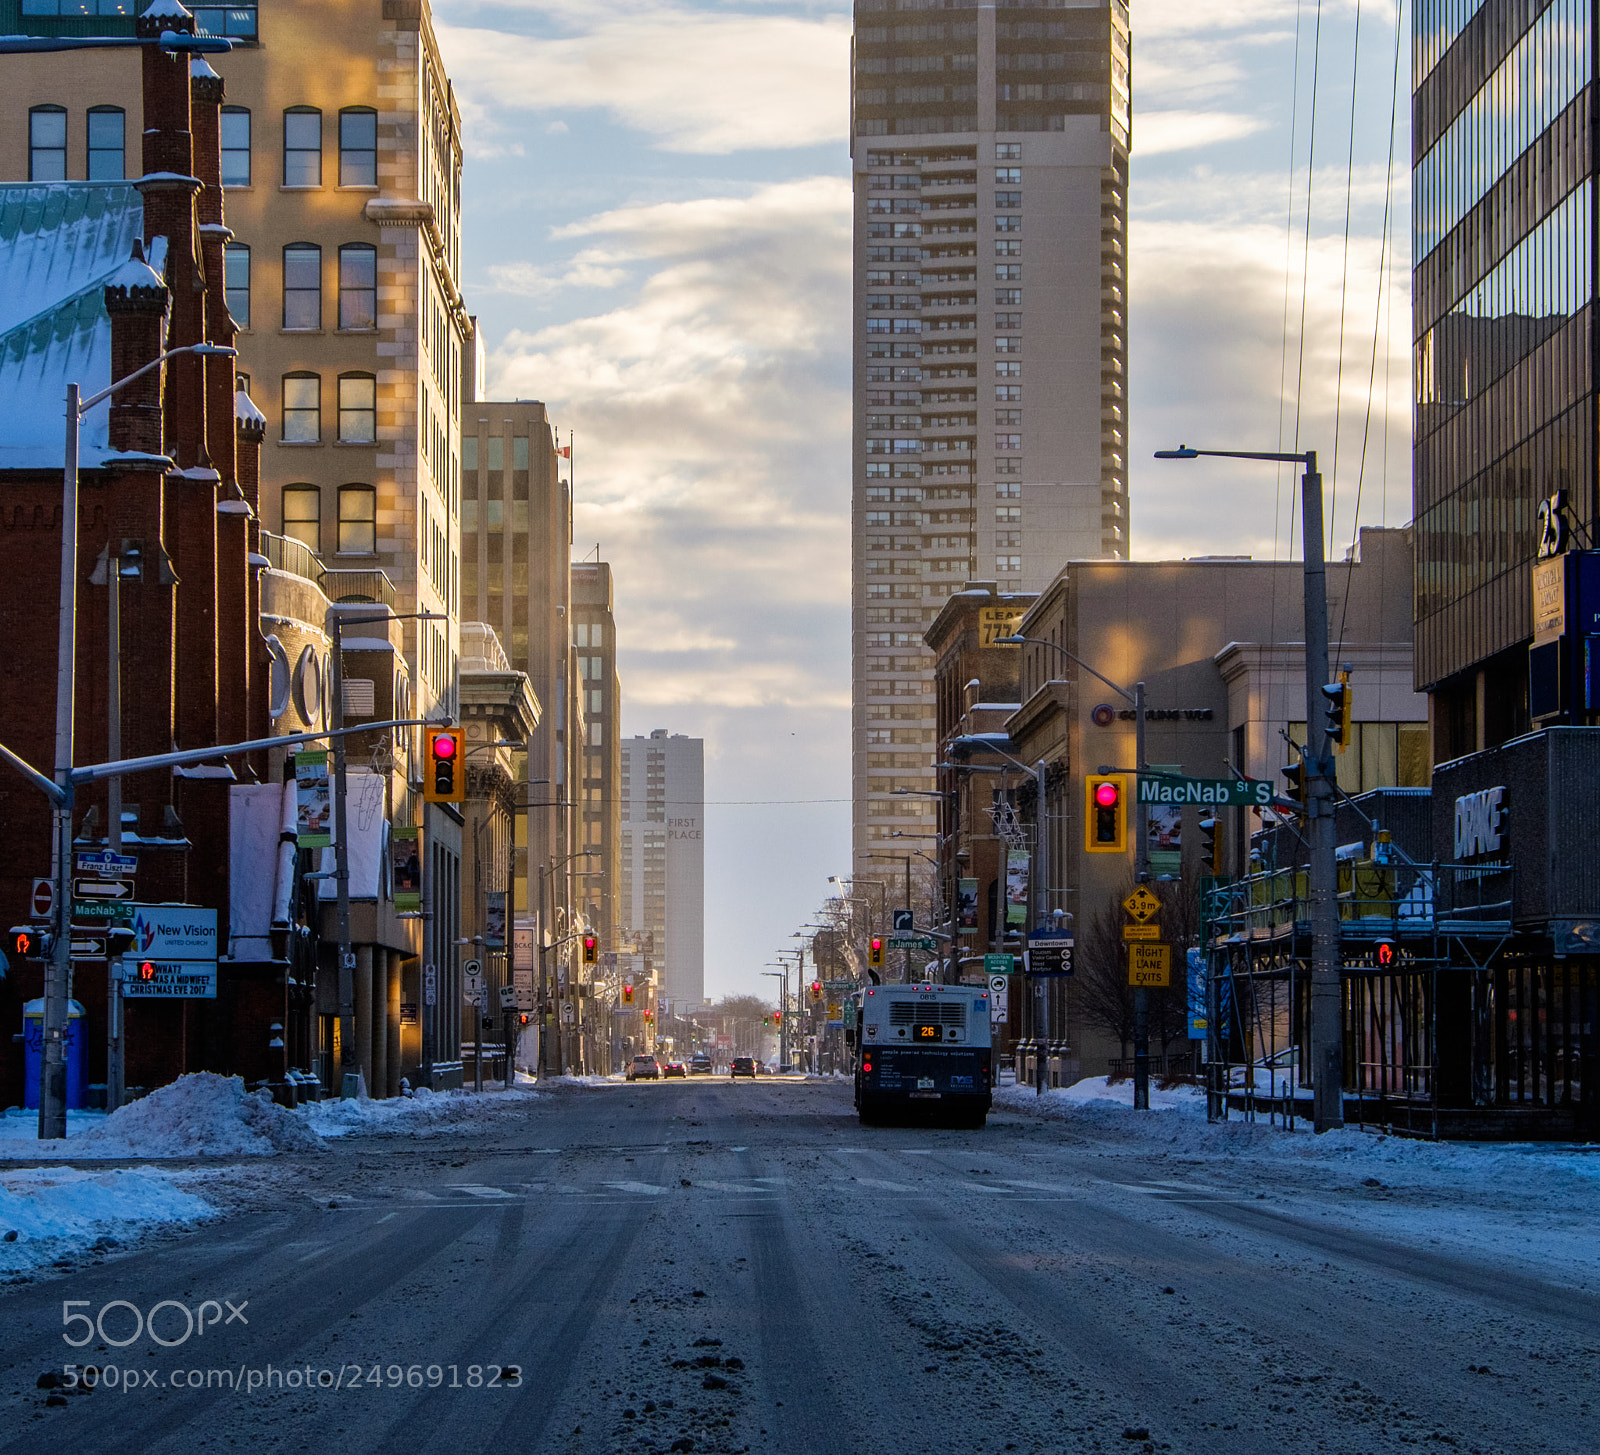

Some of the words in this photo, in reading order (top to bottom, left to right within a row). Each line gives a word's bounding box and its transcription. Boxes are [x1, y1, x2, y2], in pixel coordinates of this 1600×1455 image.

[1538, 489, 1567, 558] 25
[1141, 781, 1230, 804] MacNab
[1236, 781, 1249, 793] St
[1255, 783, 1271, 804] S
[668, 818, 696, 828] FIRST
[1454, 786, 1505, 860] DRAKE
[668, 830, 702, 840] PLACE
[82, 862, 103, 871] Franz
[104, 863, 123, 872] Liszt
[75, 905, 116, 916] MacNab
[125, 906, 133, 916] S
[157, 925, 182, 936] New
[184, 924, 216, 936] Vision
[896, 940, 923, 949] James
[930, 940, 937, 948] S
[1136, 948, 1163, 957] RIGHT
[156, 965, 182, 974] WHAT?
[1137, 960, 1162, 969] LANE
[170, 975, 175, 984] A
[177, 976, 210, 985] MIDWIFE?
[1136, 973, 1162, 982] EXITS
[130, 985, 172, 995] CHRISTMAS
[174, 985, 188, 995] EVE
[190, 986, 206, 995] 2017
[921, 1026, 935, 1037] 26
